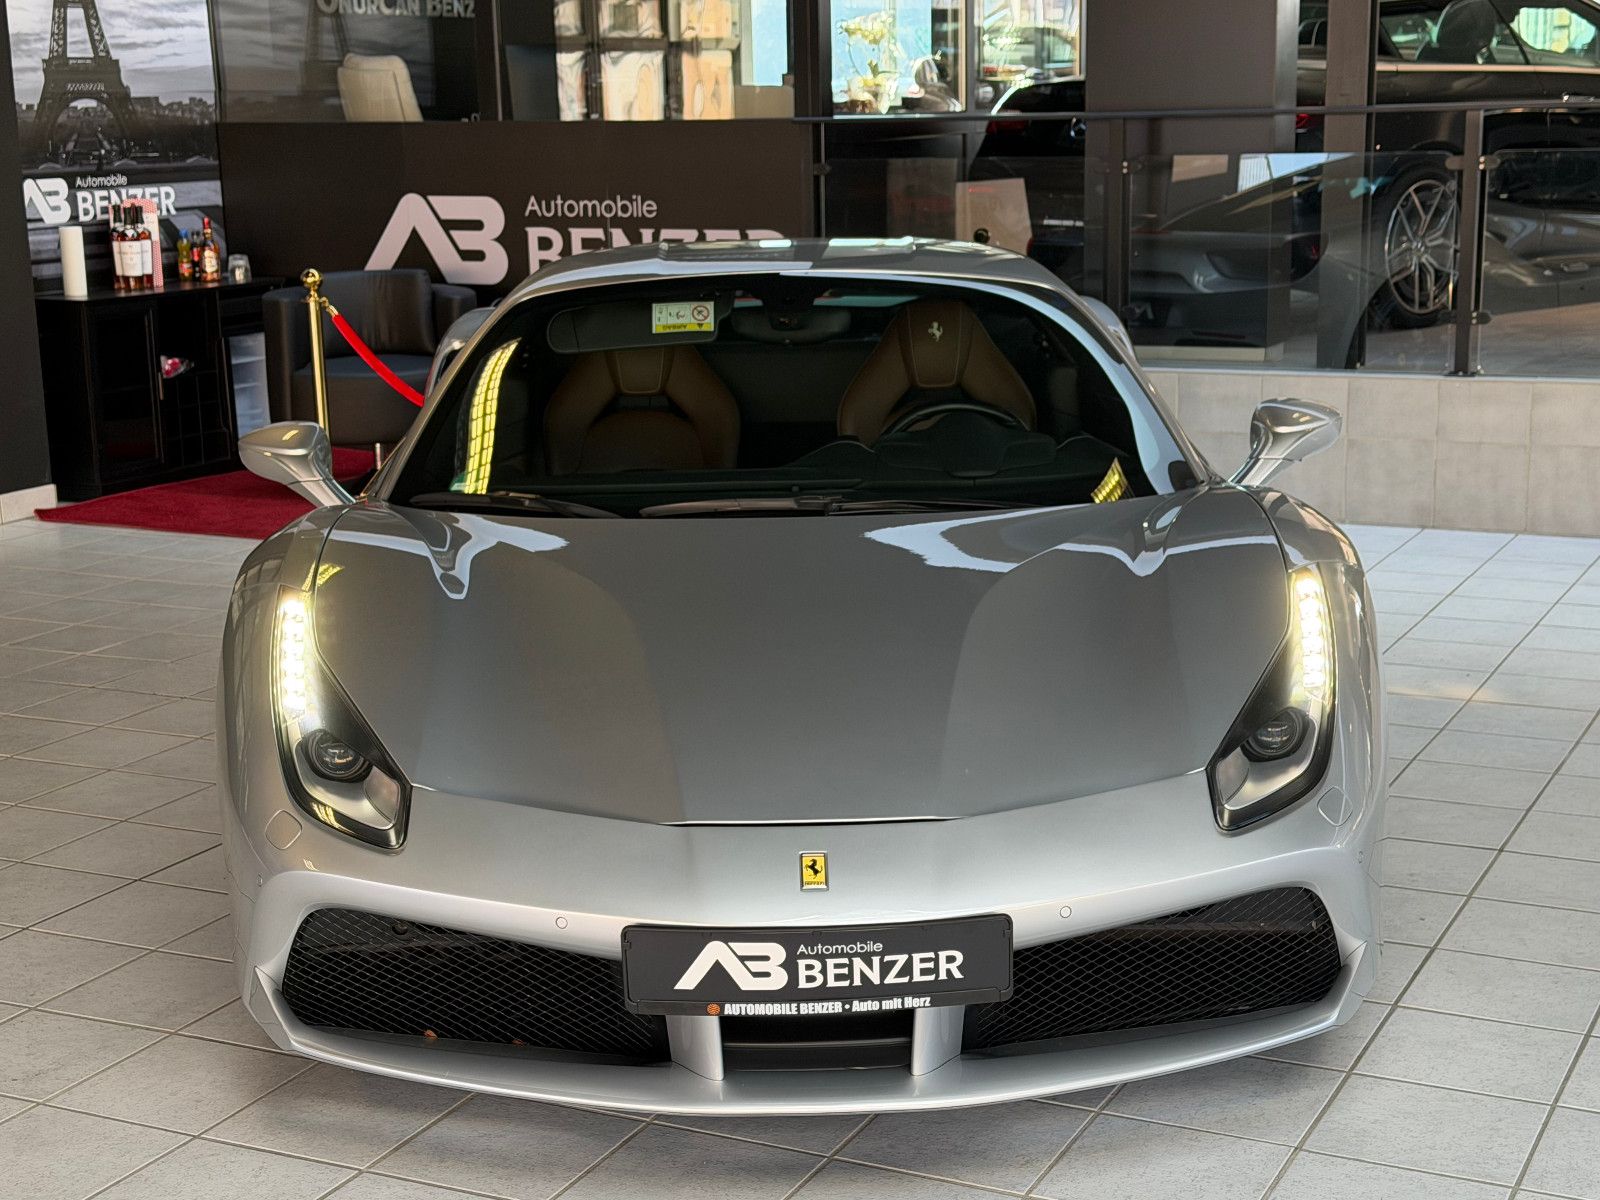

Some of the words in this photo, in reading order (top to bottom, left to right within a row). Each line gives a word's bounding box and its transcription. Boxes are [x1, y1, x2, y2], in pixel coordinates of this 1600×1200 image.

[76, 174, 128, 188] Automobile
[524, 195, 658, 219] Automobile
[364, 192, 509, 285] AB
[797, 941, 883, 955] Automobile
[673, 940, 788, 991] AB
[797, 950, 965, 989] BENZER
[724, 1002, 798, 1015] AUTOMOBILE
[800, 1001, 842, 1014] BENZER
[851, 999, 881, 1012] Auto
[882, 998, 902, 1010] mit
[904, 996, 931, 1009] Herz
